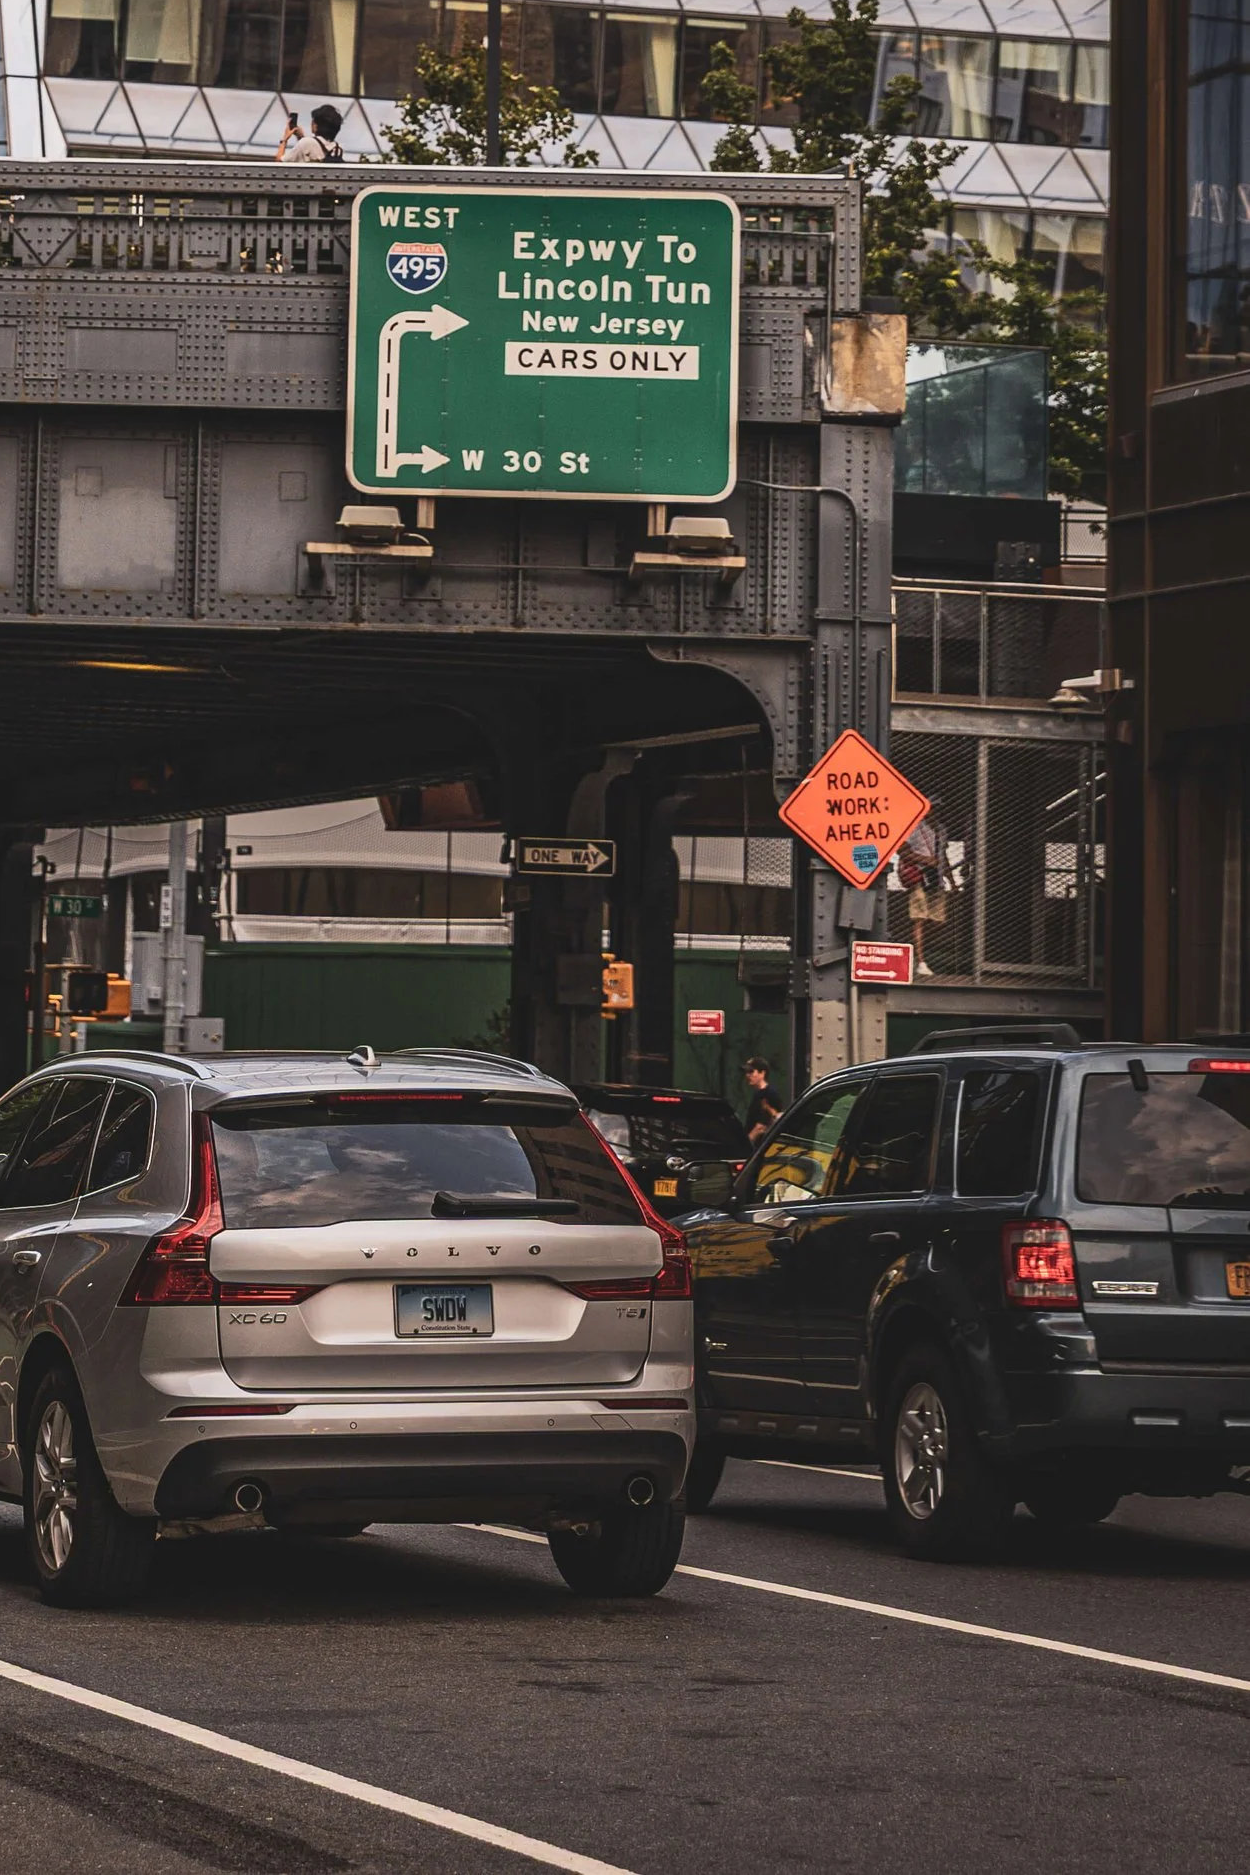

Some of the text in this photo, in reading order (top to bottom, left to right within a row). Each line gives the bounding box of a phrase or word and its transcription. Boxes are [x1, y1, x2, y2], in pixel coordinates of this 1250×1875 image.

[378, 205, 460, 229] WEST
[513, 231, 697, 269] Expwy To
[391, 256, 442, 281] 495
[497, 271, 712, 305] Lincoln Tun
[522, 310, 684, 341] New Jersey
[517, 348, 687, 372] CARS ONLY
[461, 449, 590, 474] W 30 St
[827, 771, 879, 790] ROAD
[825, 822, 890, 842] AHEAD
[531, 849, 599, 864] ONE WAY
[52, 899, 63, 914] W
[66, 899, 82, 915] 30
[360, 1243, 542, 1260] VOLVO
